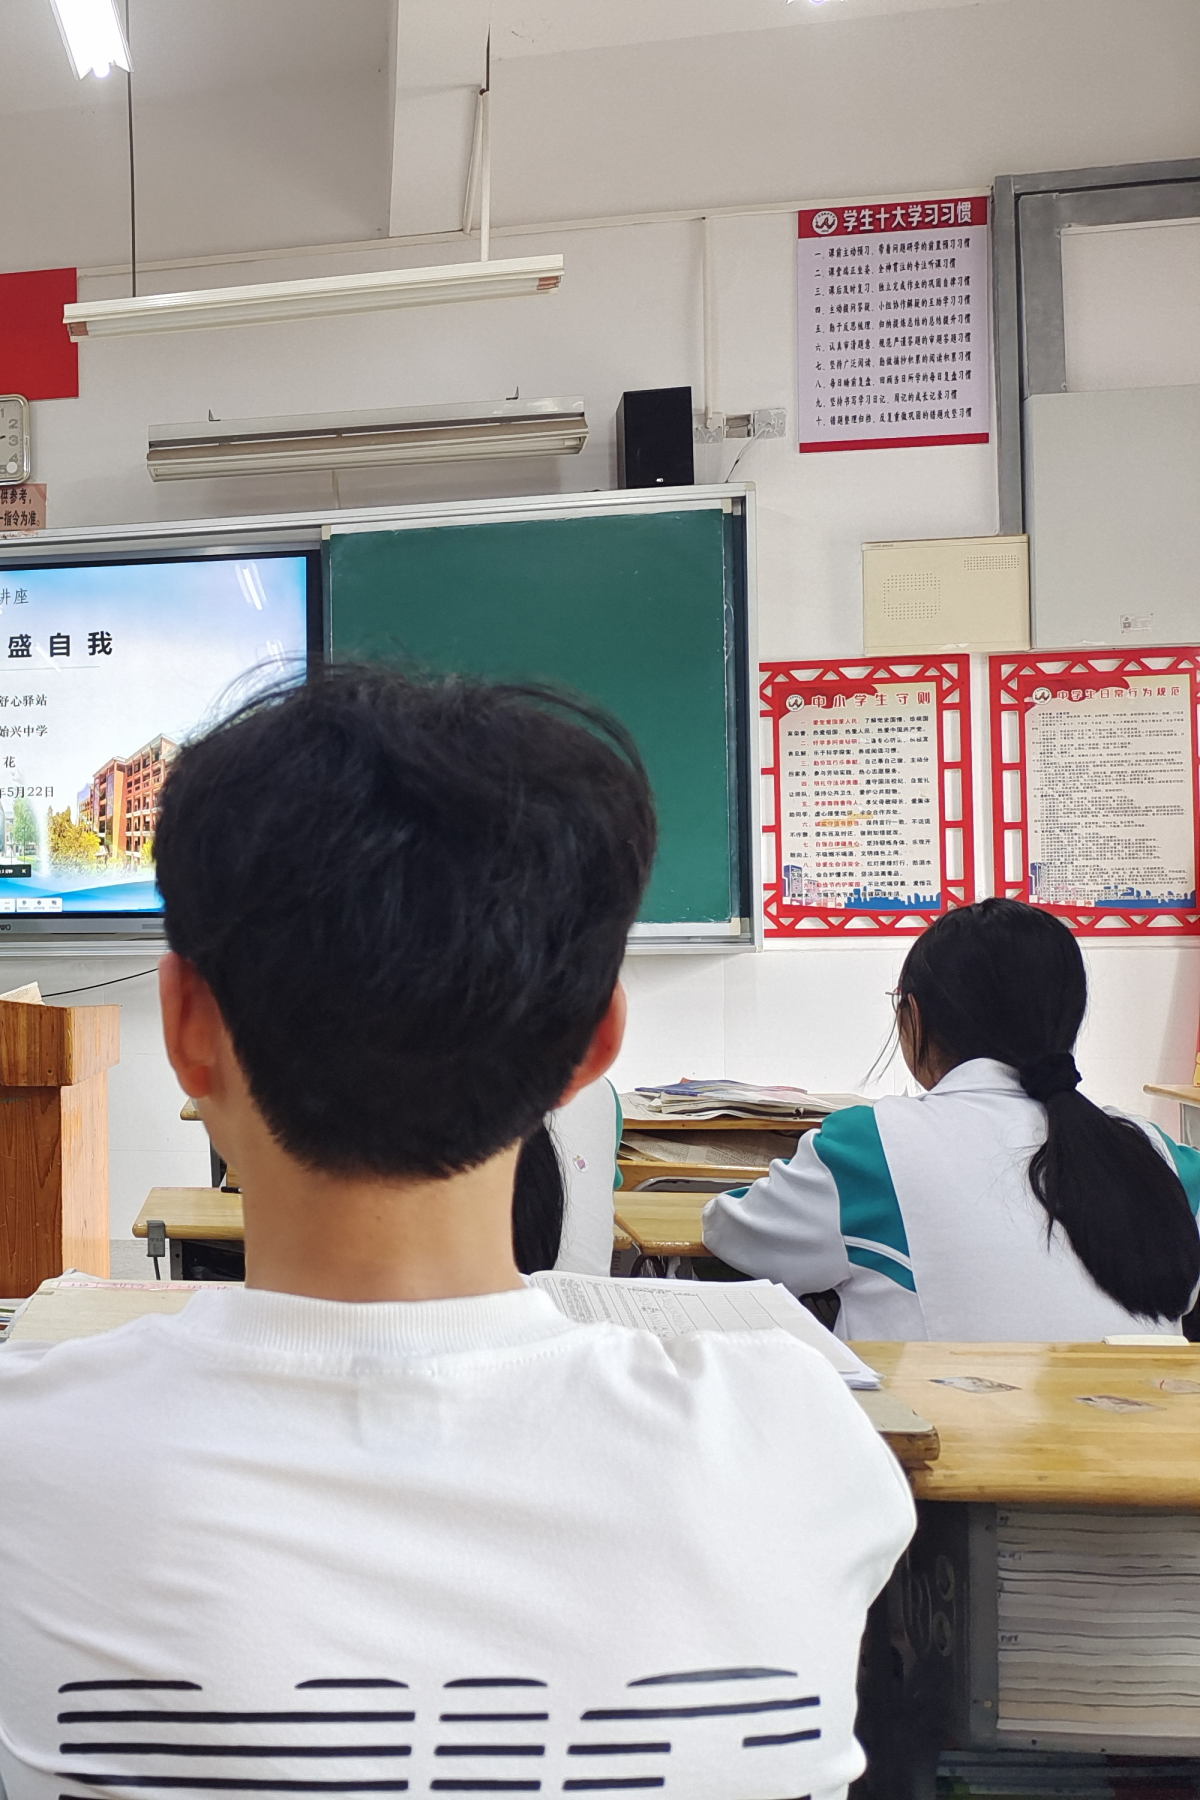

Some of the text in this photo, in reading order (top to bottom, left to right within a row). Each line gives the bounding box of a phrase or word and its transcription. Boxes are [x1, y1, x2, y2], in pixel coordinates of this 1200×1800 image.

[843, 201, 972, 232] 学生十大学习习惯
[0, 408, 5, 418] 1
[8, 419, 18, 429] 2
[8, 435, 19, 446] 3
[811, 691, 931, 708] 中小学生守则
